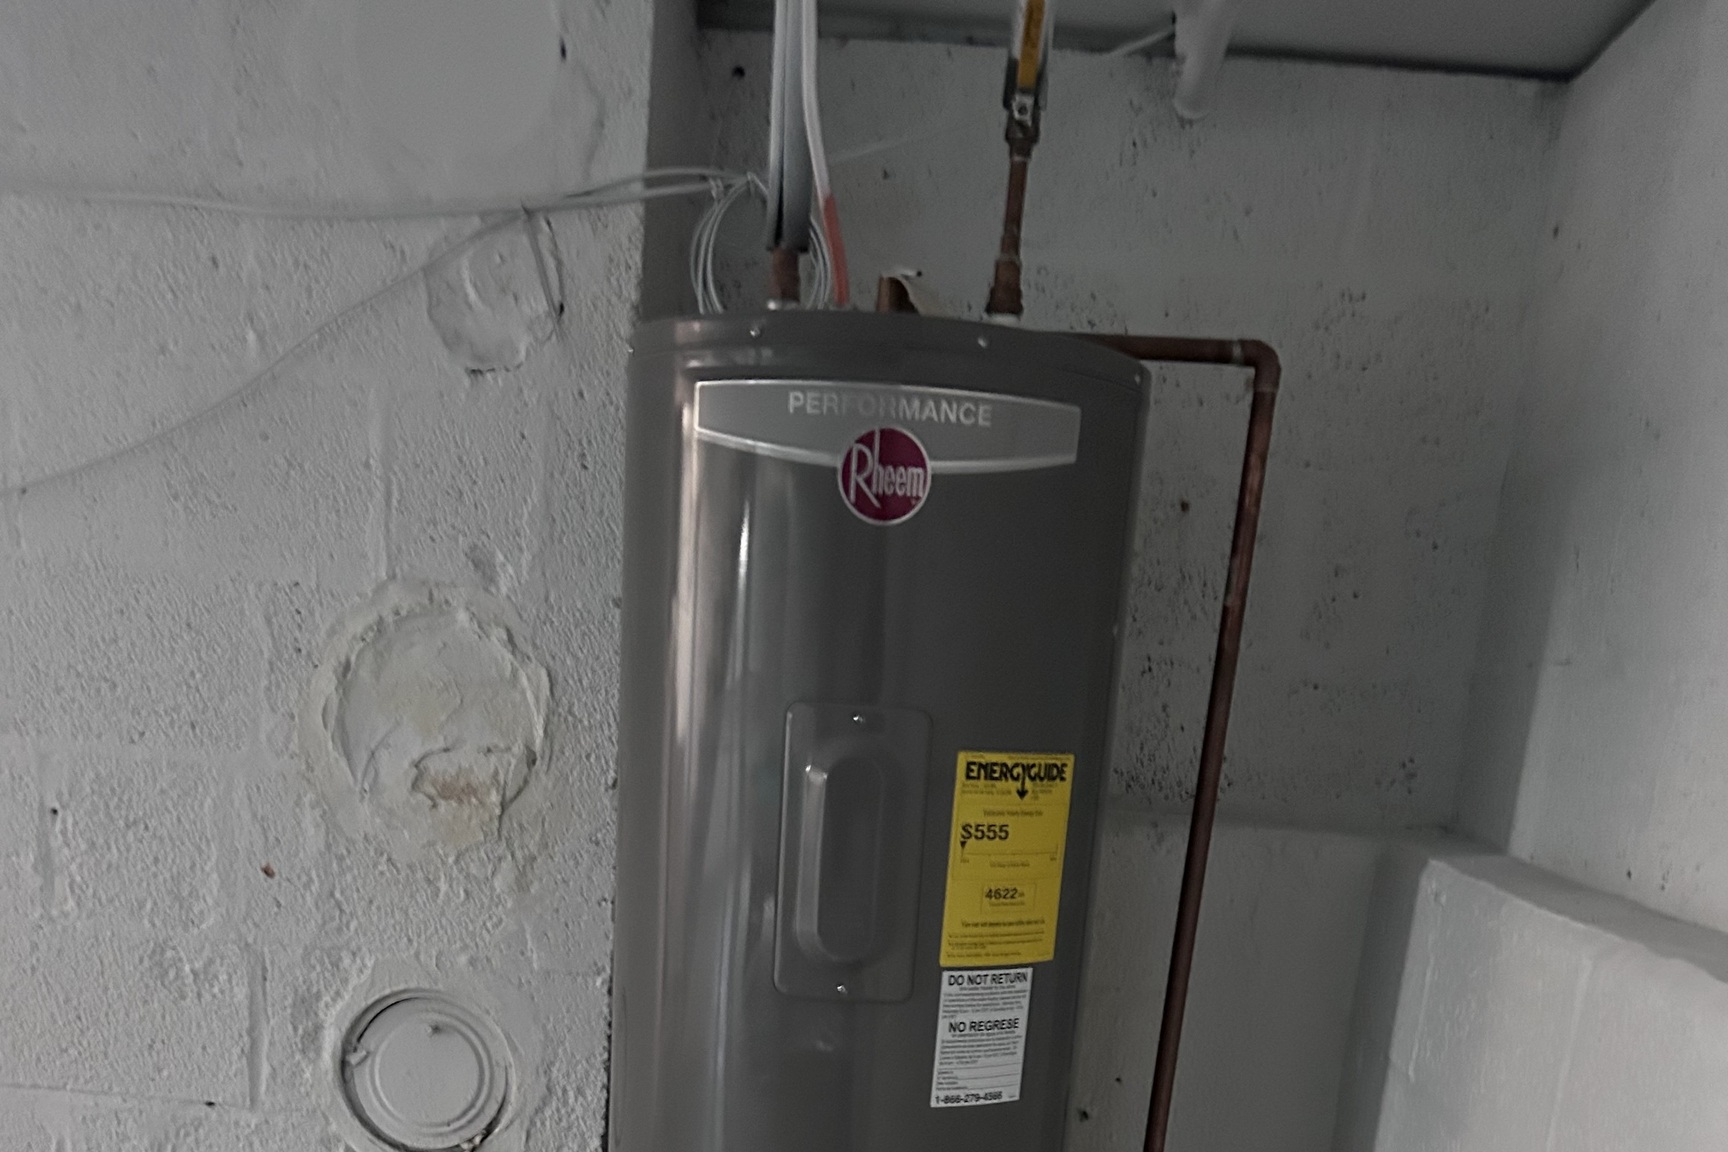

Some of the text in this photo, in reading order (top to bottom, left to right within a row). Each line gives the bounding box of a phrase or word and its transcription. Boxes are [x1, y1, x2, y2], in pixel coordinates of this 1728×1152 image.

[788, 391, 993, 427] PERFORMANCE
[849, 428, 925, 509] Rheem
[960, 823, 1010, 841] $555
[984, 886, 1018, 900] 4622
[948, 971, 1029, 987] DO NOT RETURN
[948, 1021, 966, 1034] NO
[969, 1017, 1020, 1032] REGRESE
